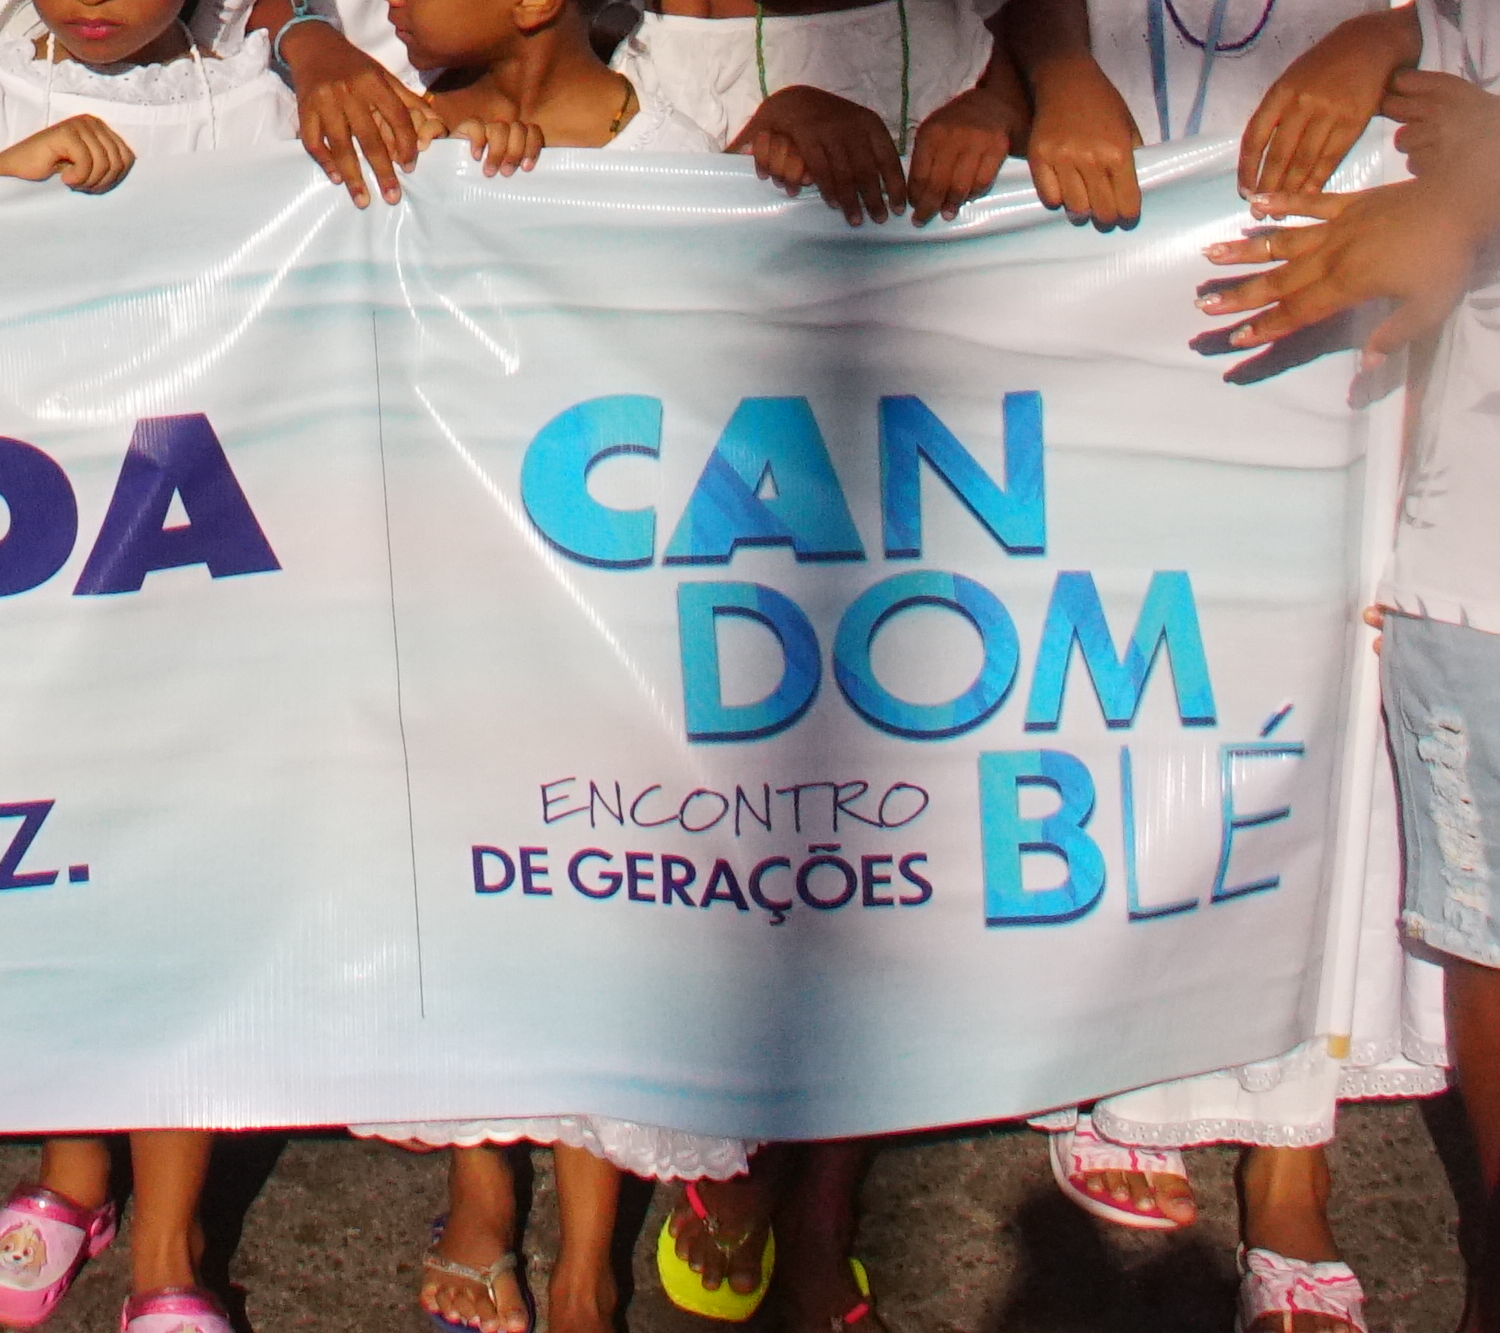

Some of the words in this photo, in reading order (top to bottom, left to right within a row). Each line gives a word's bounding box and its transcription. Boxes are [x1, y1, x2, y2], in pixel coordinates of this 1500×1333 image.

[519, 390, 1046, 569] CAN
[676, 570, 1218, 746] DOM
[472, 843, 555, 896] DE
[566, 842, 934, 927] GERAÇÕES
[539, 776, 930, 836] ENCONTRO
[978, 703, 1305, 928] BLÉ
